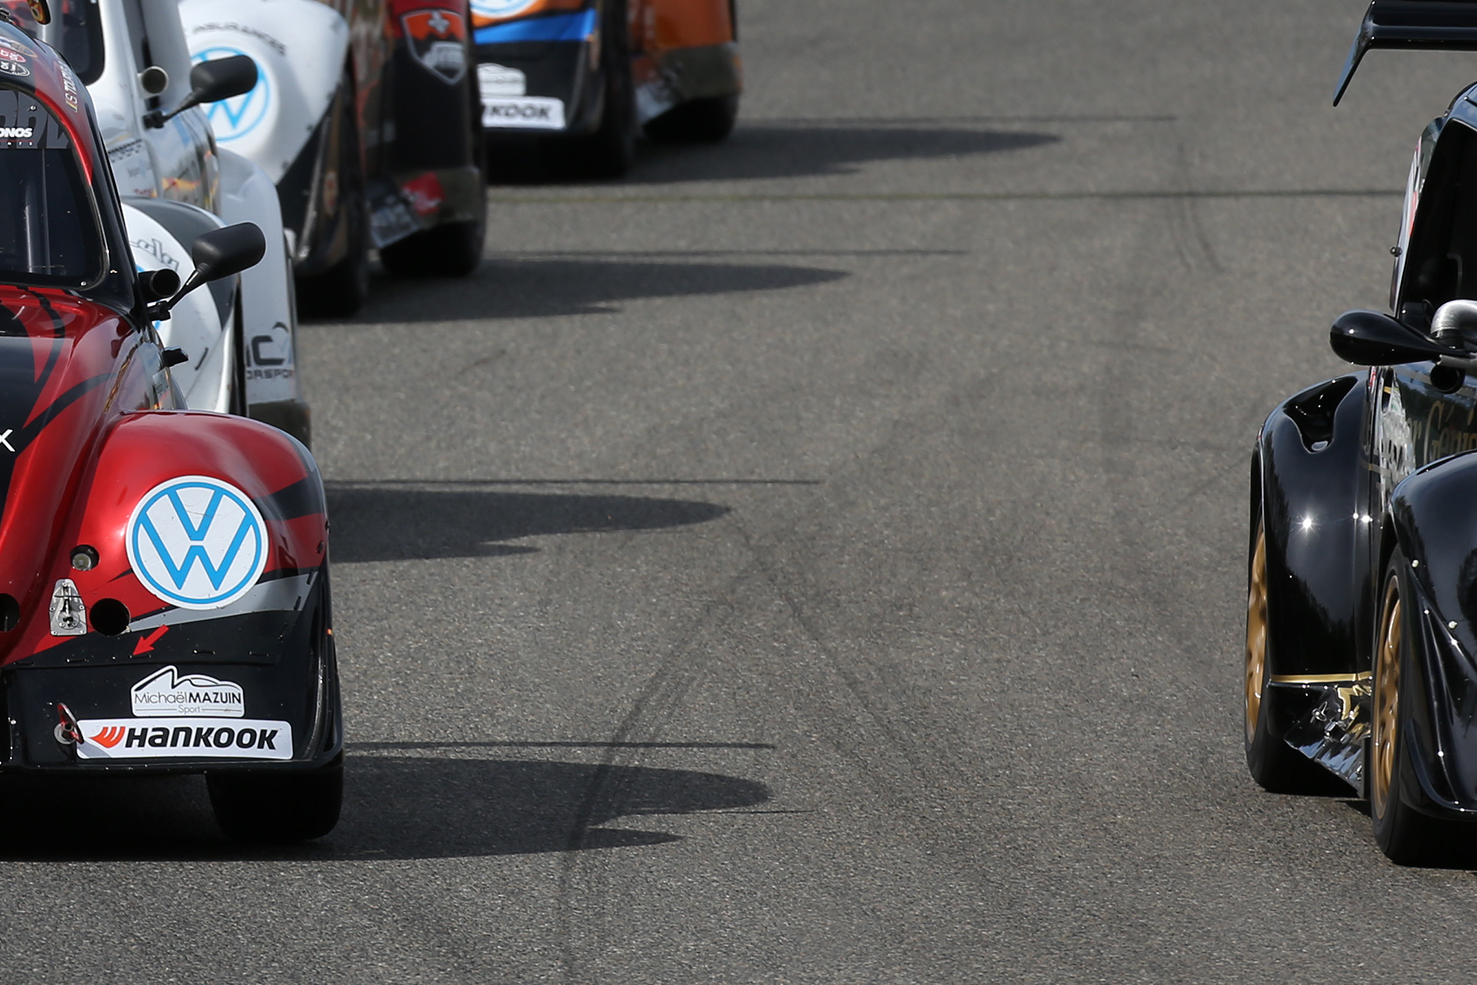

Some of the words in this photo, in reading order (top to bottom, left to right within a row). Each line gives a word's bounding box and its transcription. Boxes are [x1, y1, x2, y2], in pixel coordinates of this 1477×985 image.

[484, 103, 551, 120] KOOK
[178, 704, 201, 714] Sport
[125, 726, 278, 750] HANKOOK
